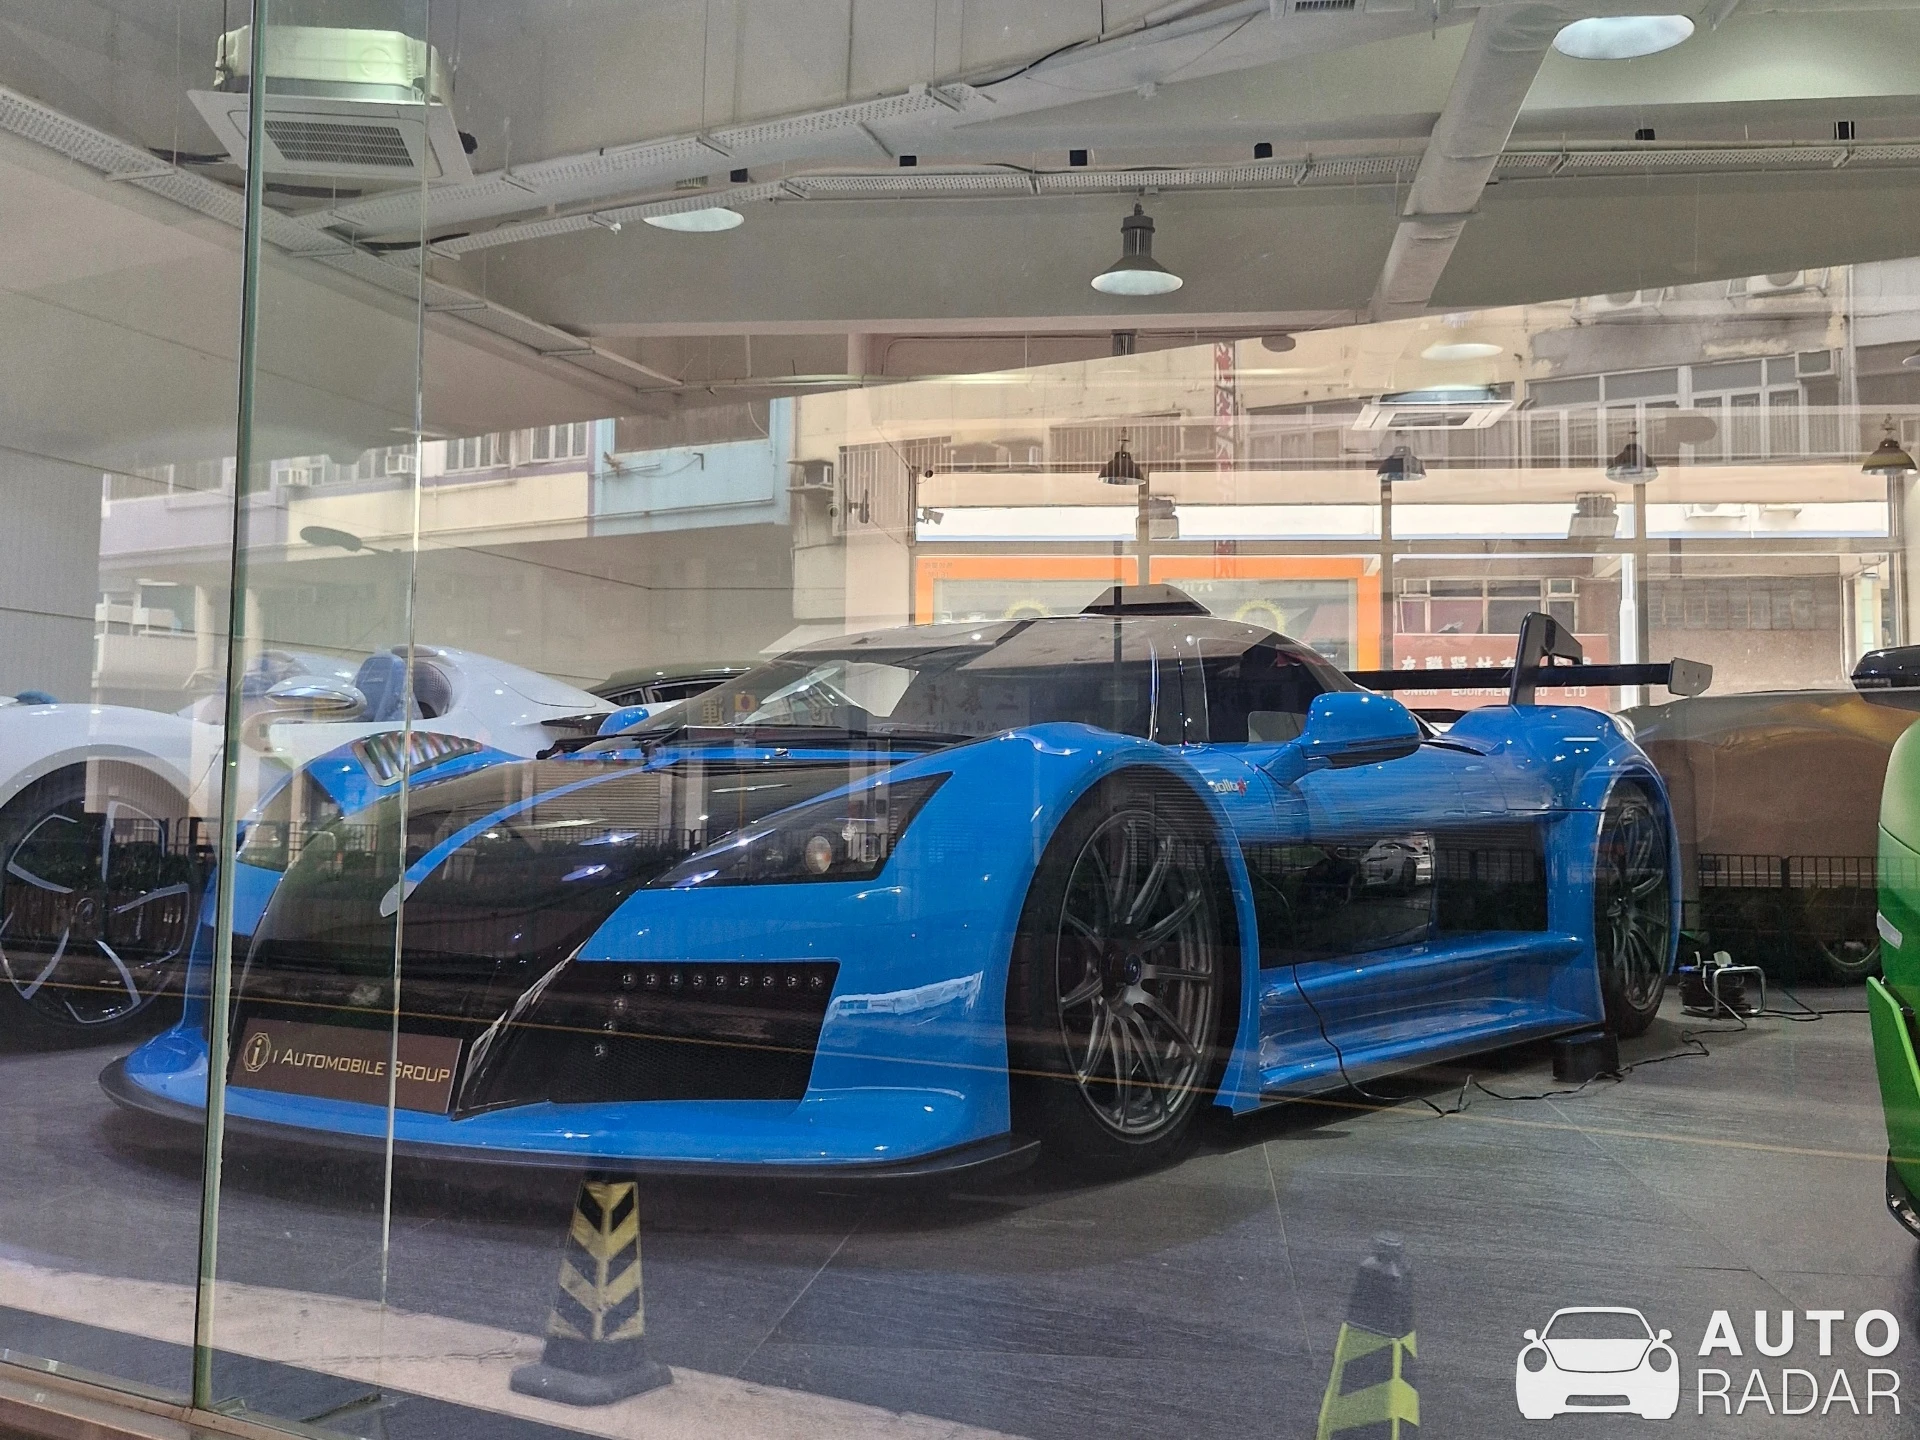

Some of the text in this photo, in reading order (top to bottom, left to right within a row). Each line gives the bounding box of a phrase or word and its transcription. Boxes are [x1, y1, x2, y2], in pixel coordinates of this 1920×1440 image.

[1451, 687, 1510, 697] EQUIPMEN
[1564, 686, 1587, 698] LTD
[281, 1048, 387, 1076] AUTOMOBILE
[393, 1060, 450, 1083] GROUP
